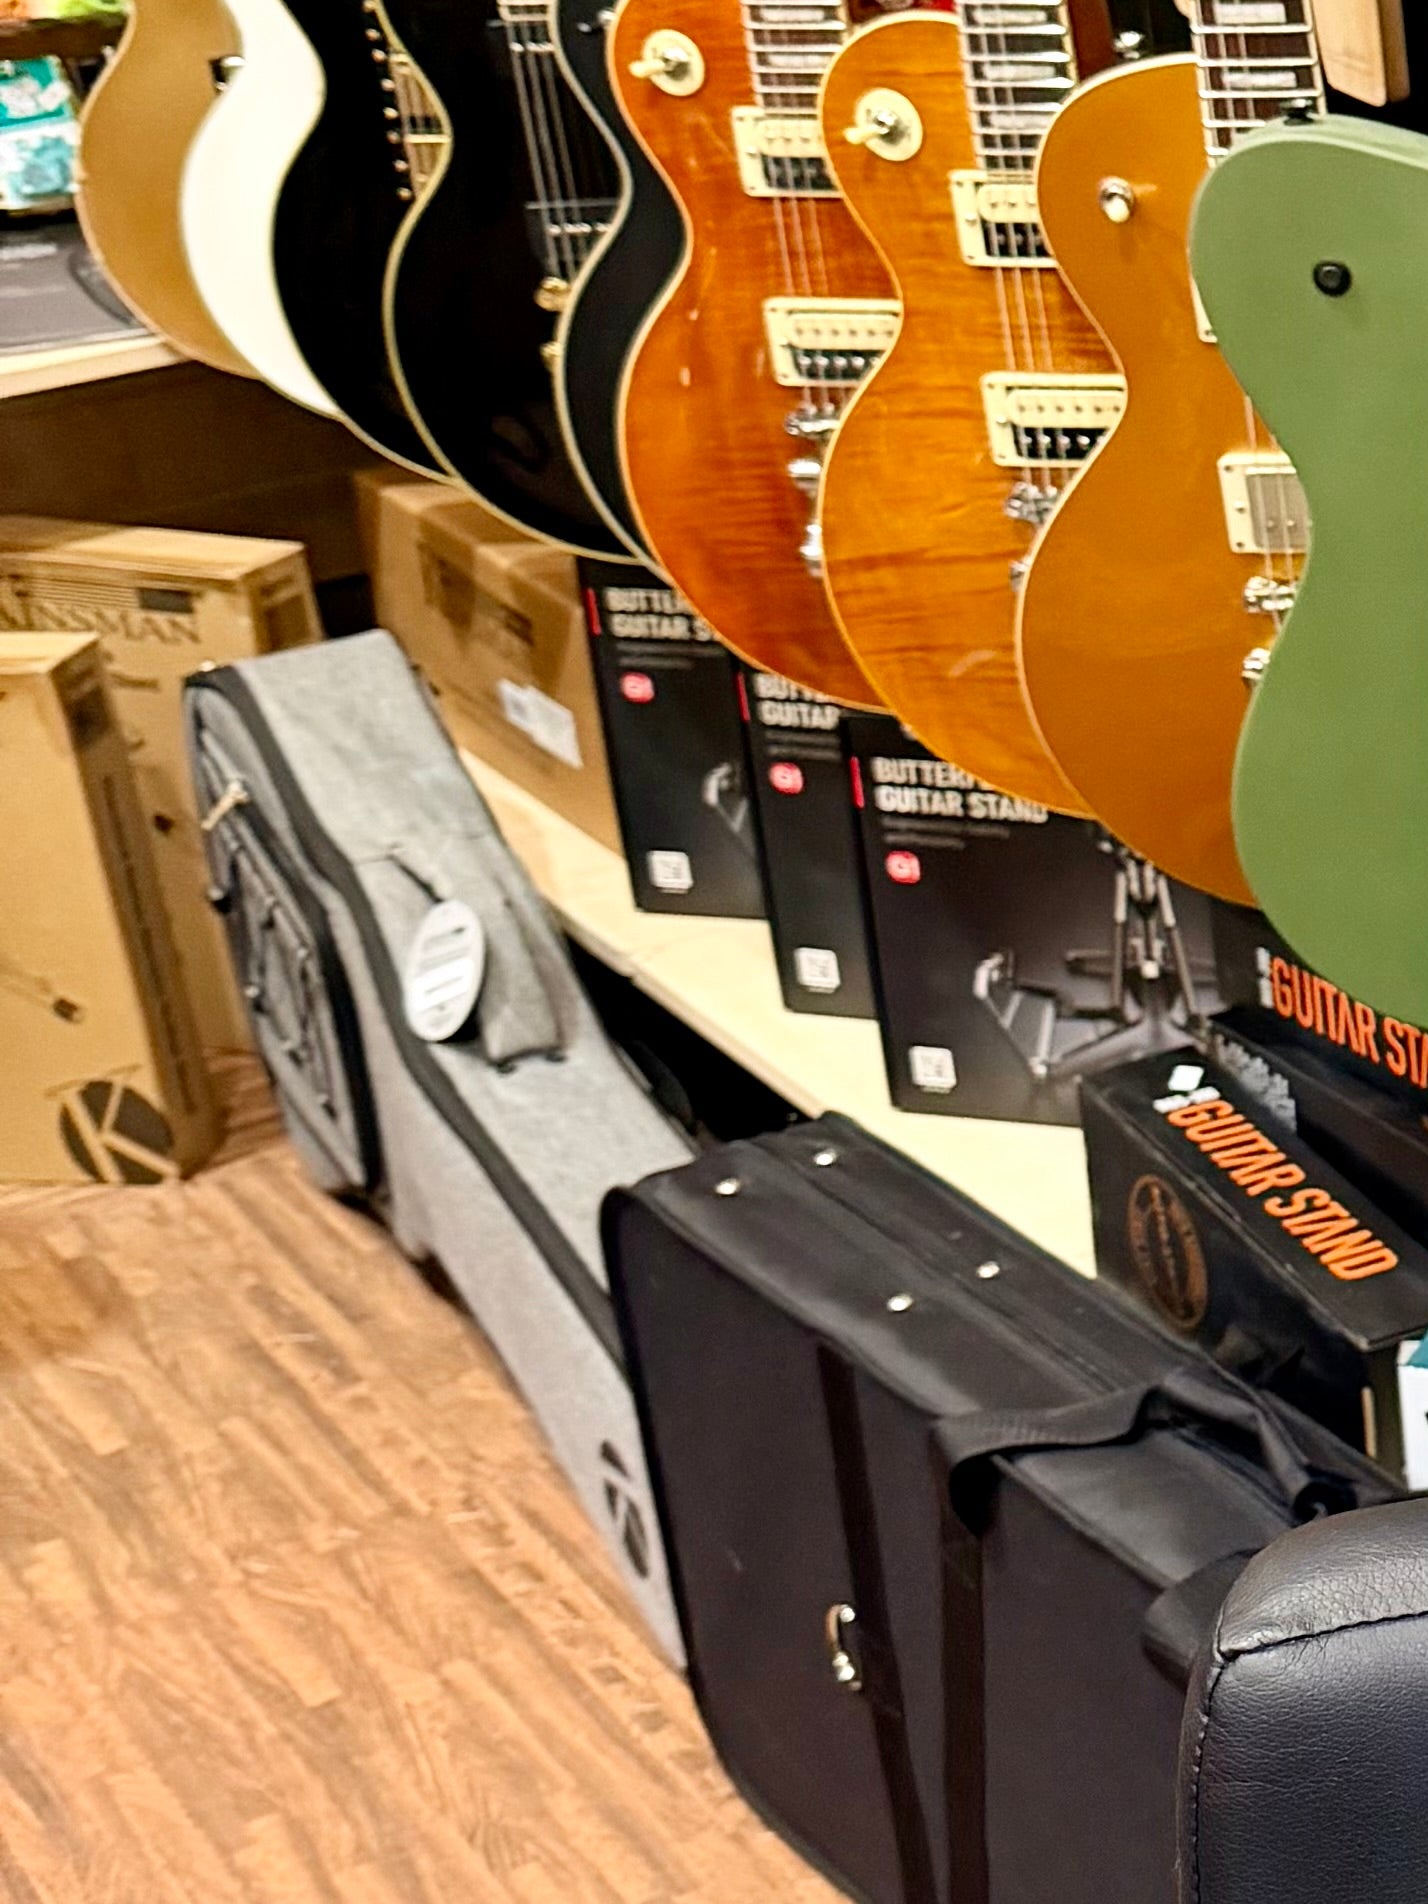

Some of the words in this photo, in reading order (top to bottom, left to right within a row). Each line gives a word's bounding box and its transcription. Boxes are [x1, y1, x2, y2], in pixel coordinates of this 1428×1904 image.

[875, 786, 964, 816] GUITAR
[969, 790, 1049, 825] STAND
[1270, 956, 1380, 1063] GUITAR
[1165, 1098, 1306, 1197] GUITAR
[1264, 1187, 1398, 1282] STAND
